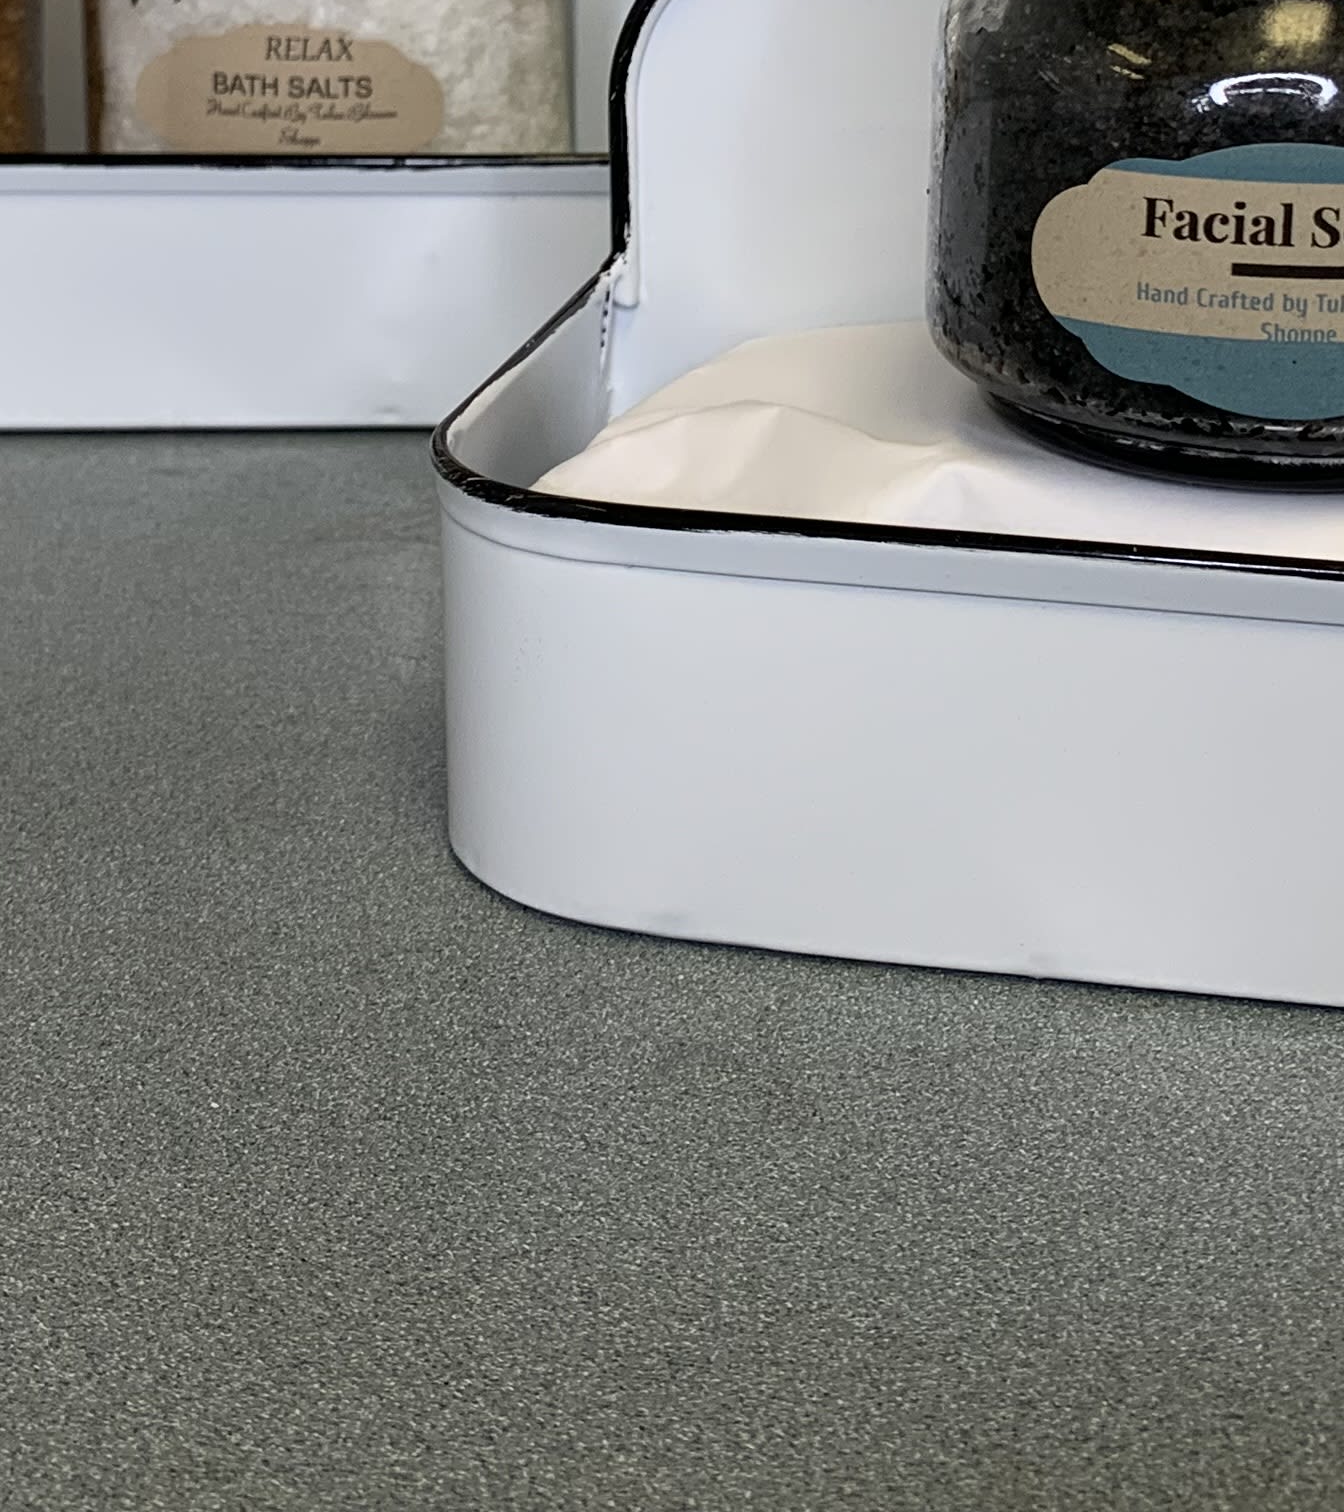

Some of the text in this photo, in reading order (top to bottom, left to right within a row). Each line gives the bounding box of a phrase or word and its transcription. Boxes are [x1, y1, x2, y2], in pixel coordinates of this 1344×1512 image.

[264, 35, 354, 62] RELAX
[212, 71, 373, 100] BATH SALTS
[1141, 196, 1295, 248] Facial
[1136, 281, 1188, 306] Hand
[1196, 287, 1274, 312] Crafted
[1282, 293, 1308, 318] by
